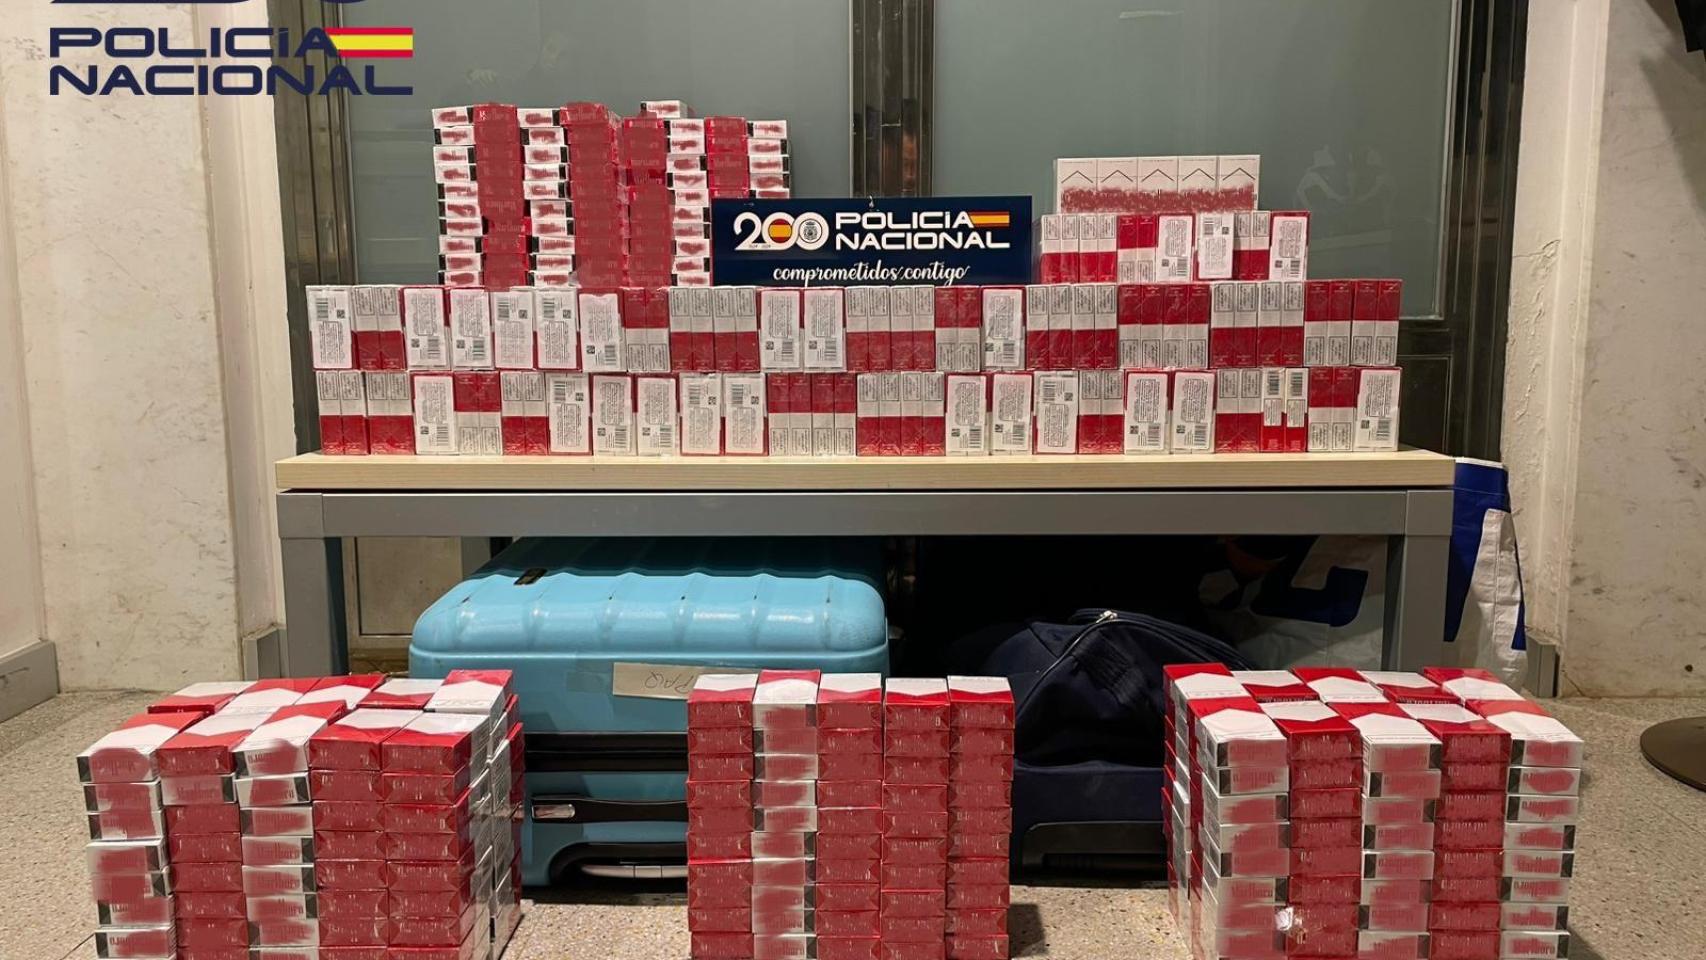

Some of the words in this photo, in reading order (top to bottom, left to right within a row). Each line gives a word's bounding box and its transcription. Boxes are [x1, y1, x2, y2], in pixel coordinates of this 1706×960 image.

[733, 211, 830, 251] 200
[835, 231, 1011, 250] NACIONAL
[773, 259, 901, 287] comprometidos
[901, 261, 971, 286] contigo
